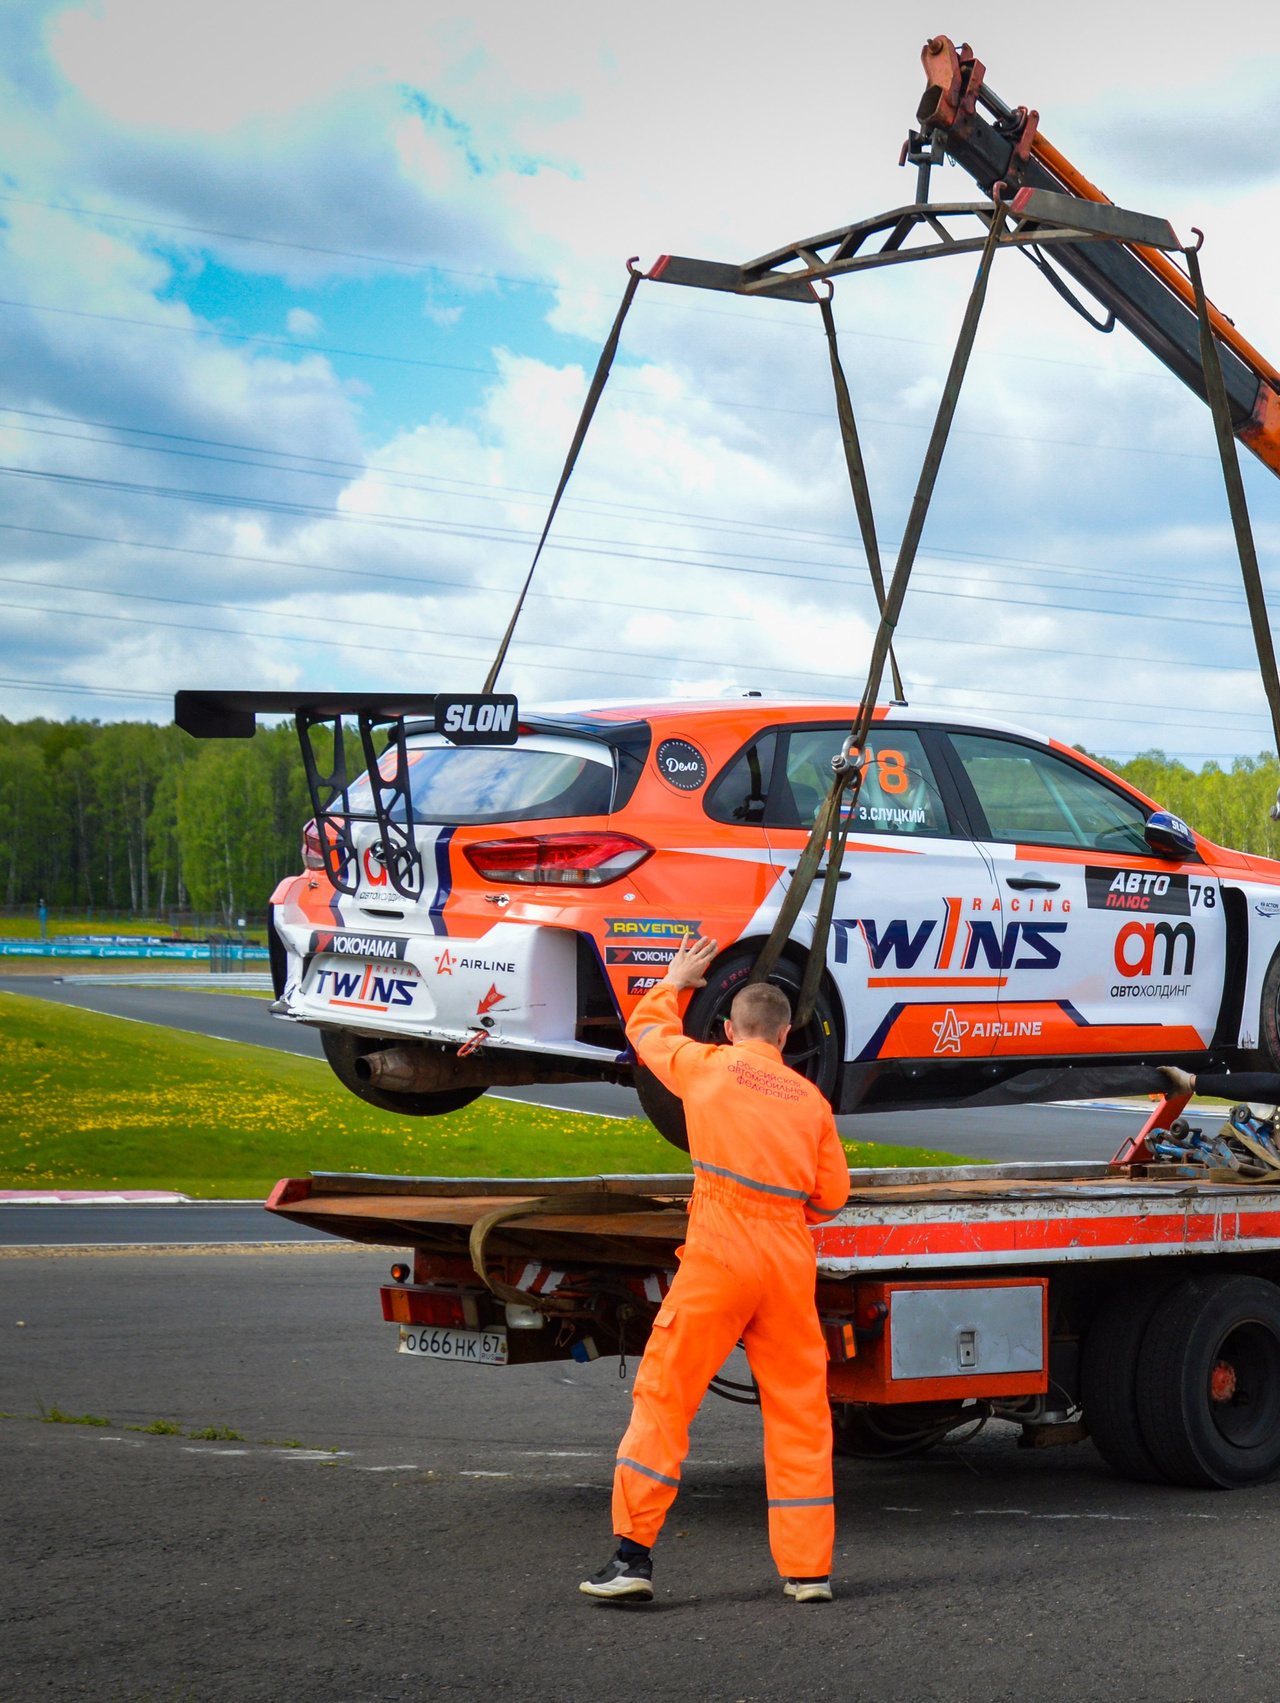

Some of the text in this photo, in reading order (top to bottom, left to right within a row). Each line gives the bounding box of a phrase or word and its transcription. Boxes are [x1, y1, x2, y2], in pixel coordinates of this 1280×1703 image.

[444, 704, 515, 732] SLON
[1109, 872, 1170, 896] АВТО
[972, 897, 1072, 913] RACING
[1105, 893, 1151, 910] ПЛЮС
[1189, 885, 1216, 909] 78
[613, 922, 695, 935] RAVENOL
[832, 897, 1069, 970] TWINS
[333, 936, 397, 958] YOKOHAMA
[1113, 921, 1196, 978] am
[632, 951, 677, 962] YOKOHA
[375, 966, 421, 978] RACING
[460, 959, 515, 972] AIRLINE
[317, 964, 418, 1006] TWINS
[971, 1021, 1042, 1037] AIRLINE
[482, 1335, 500, 1353] 67
[481, 1352, 495, 1360] RUS
